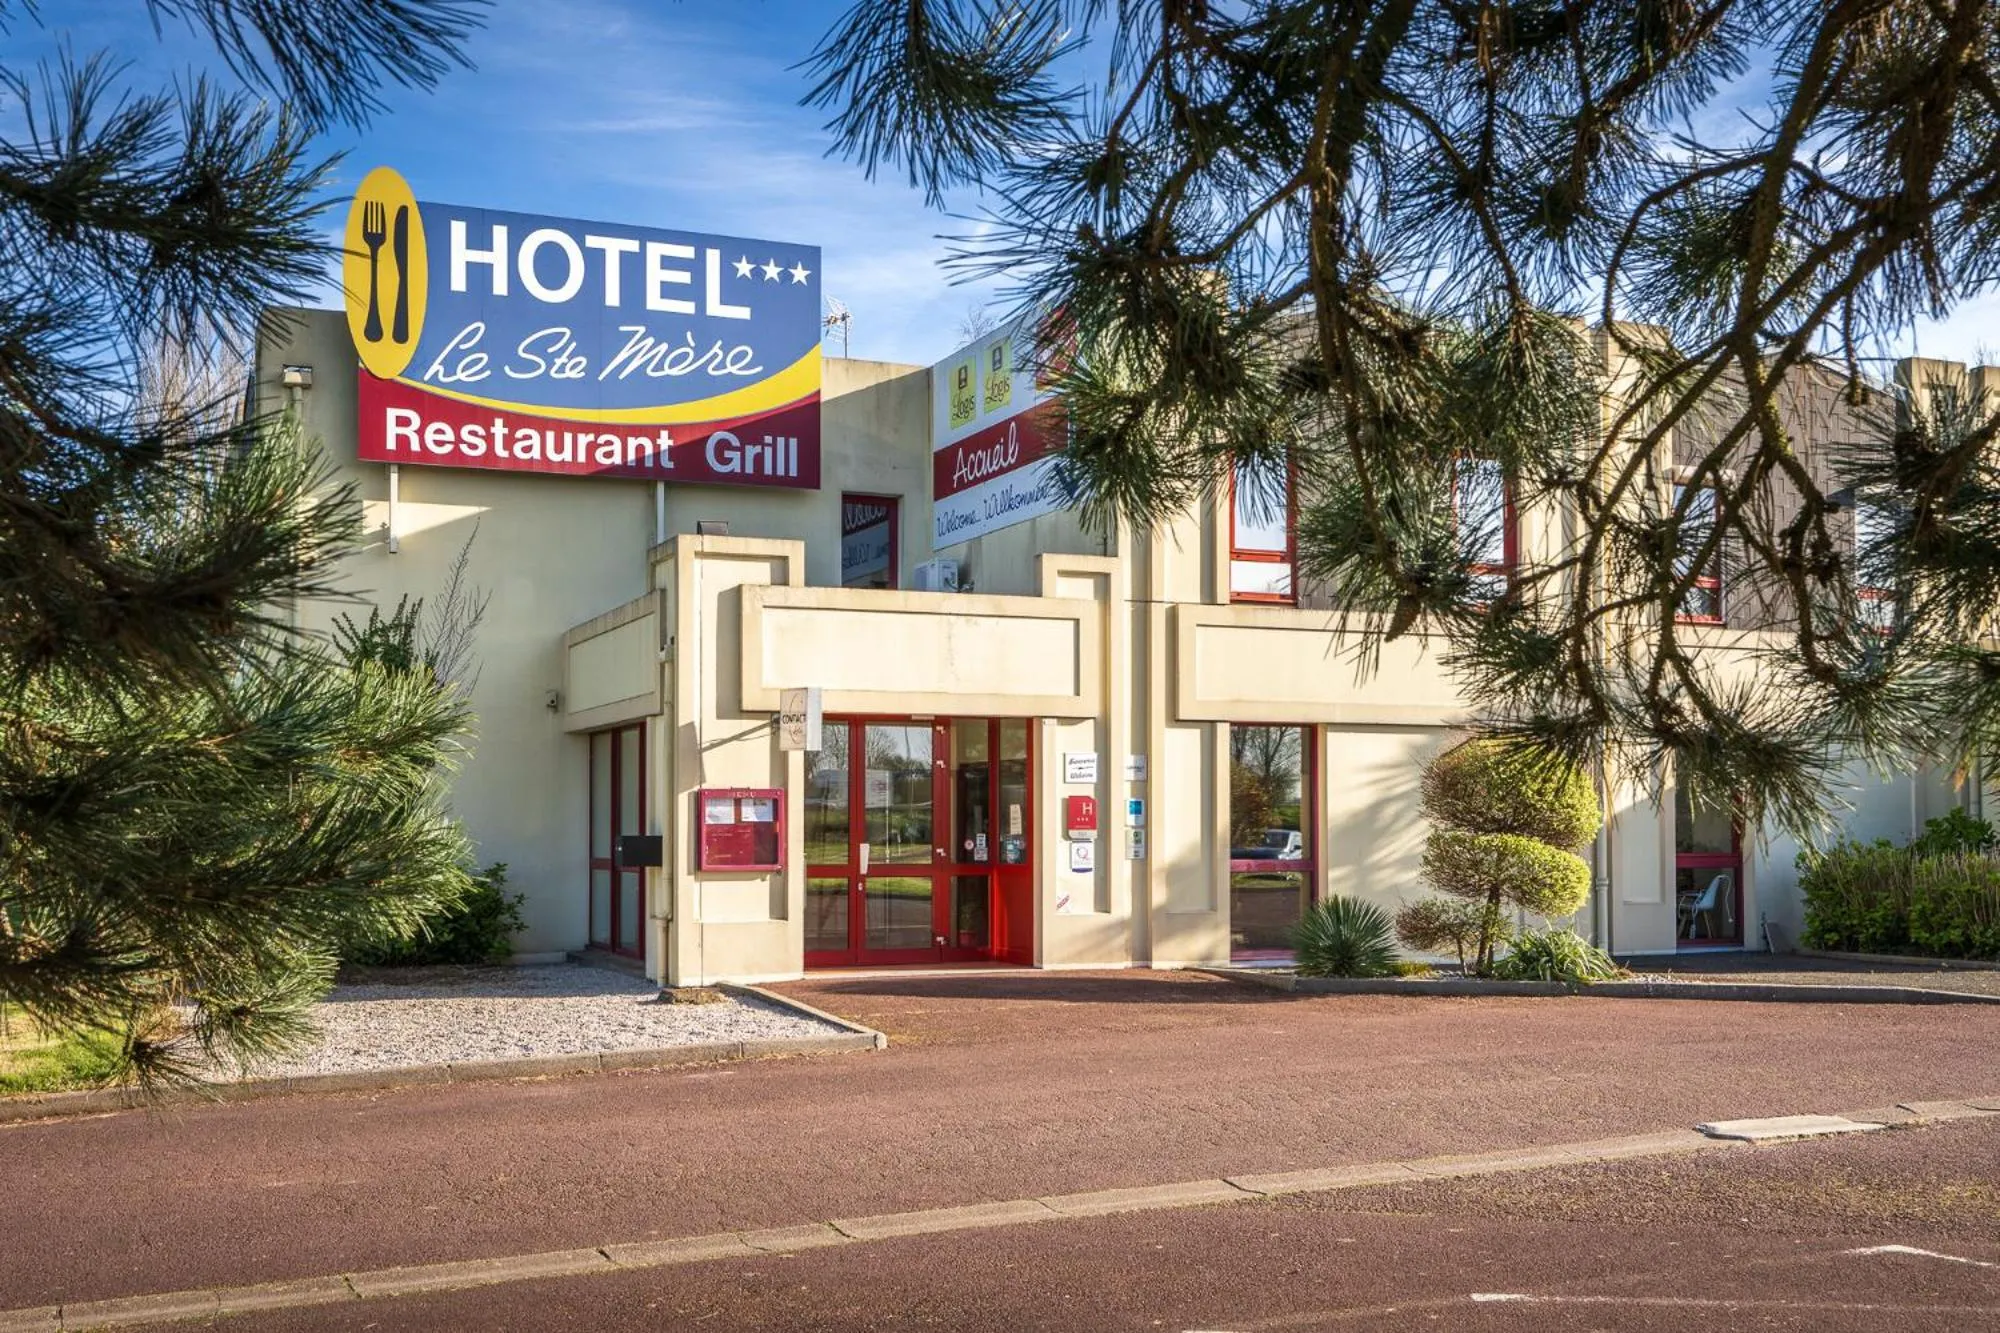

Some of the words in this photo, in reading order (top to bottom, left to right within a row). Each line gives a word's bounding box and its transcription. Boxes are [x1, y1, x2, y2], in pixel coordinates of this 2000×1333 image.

[449, 219, 751, 320] HOTEL
[424, 321, 492, 383] Le
[503, 327, 586, 380] Ste
[597, 325, 763, 382] Mère
[385, 407, 674, 469] Restaurant
[705, 431, 797, 477] Grill
[953, 421, 1019, 489] Accueil
[782, 713, 806, 725] CONTACT
[1082, 802, 1093, 815] H
